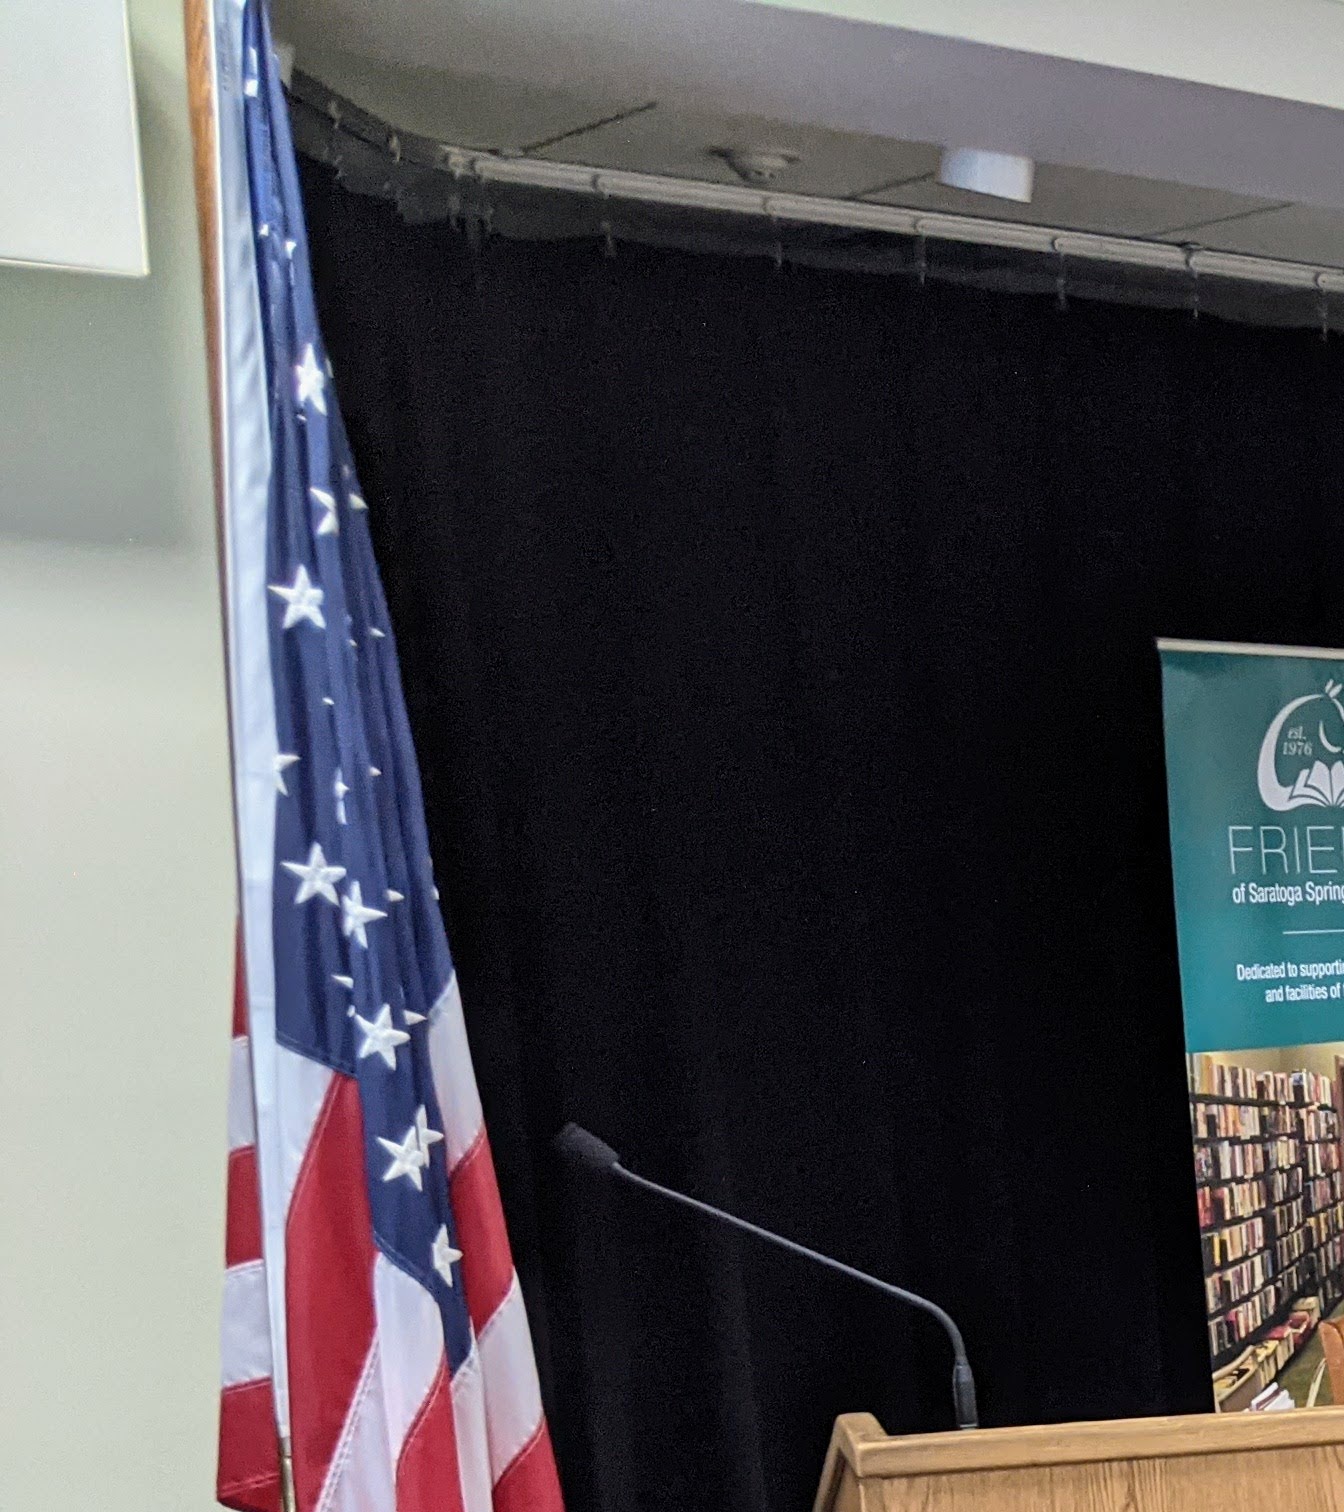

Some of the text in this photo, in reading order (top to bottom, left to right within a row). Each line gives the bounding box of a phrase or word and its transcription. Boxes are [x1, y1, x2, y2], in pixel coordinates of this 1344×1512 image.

[1282, 741, 1313, 756] 1976
[1232, 883, 1246, 904] of
[1248, 881, 1304, 907] Saratoga
[1236, 962, 1286, 981] Dedicated
[1287, 962, 1298, 978] to
[1265, 985, 1284, 1003] and
[1285, 984, 1328, 1002] facilities
[1329, 981, 1342, 999] of
